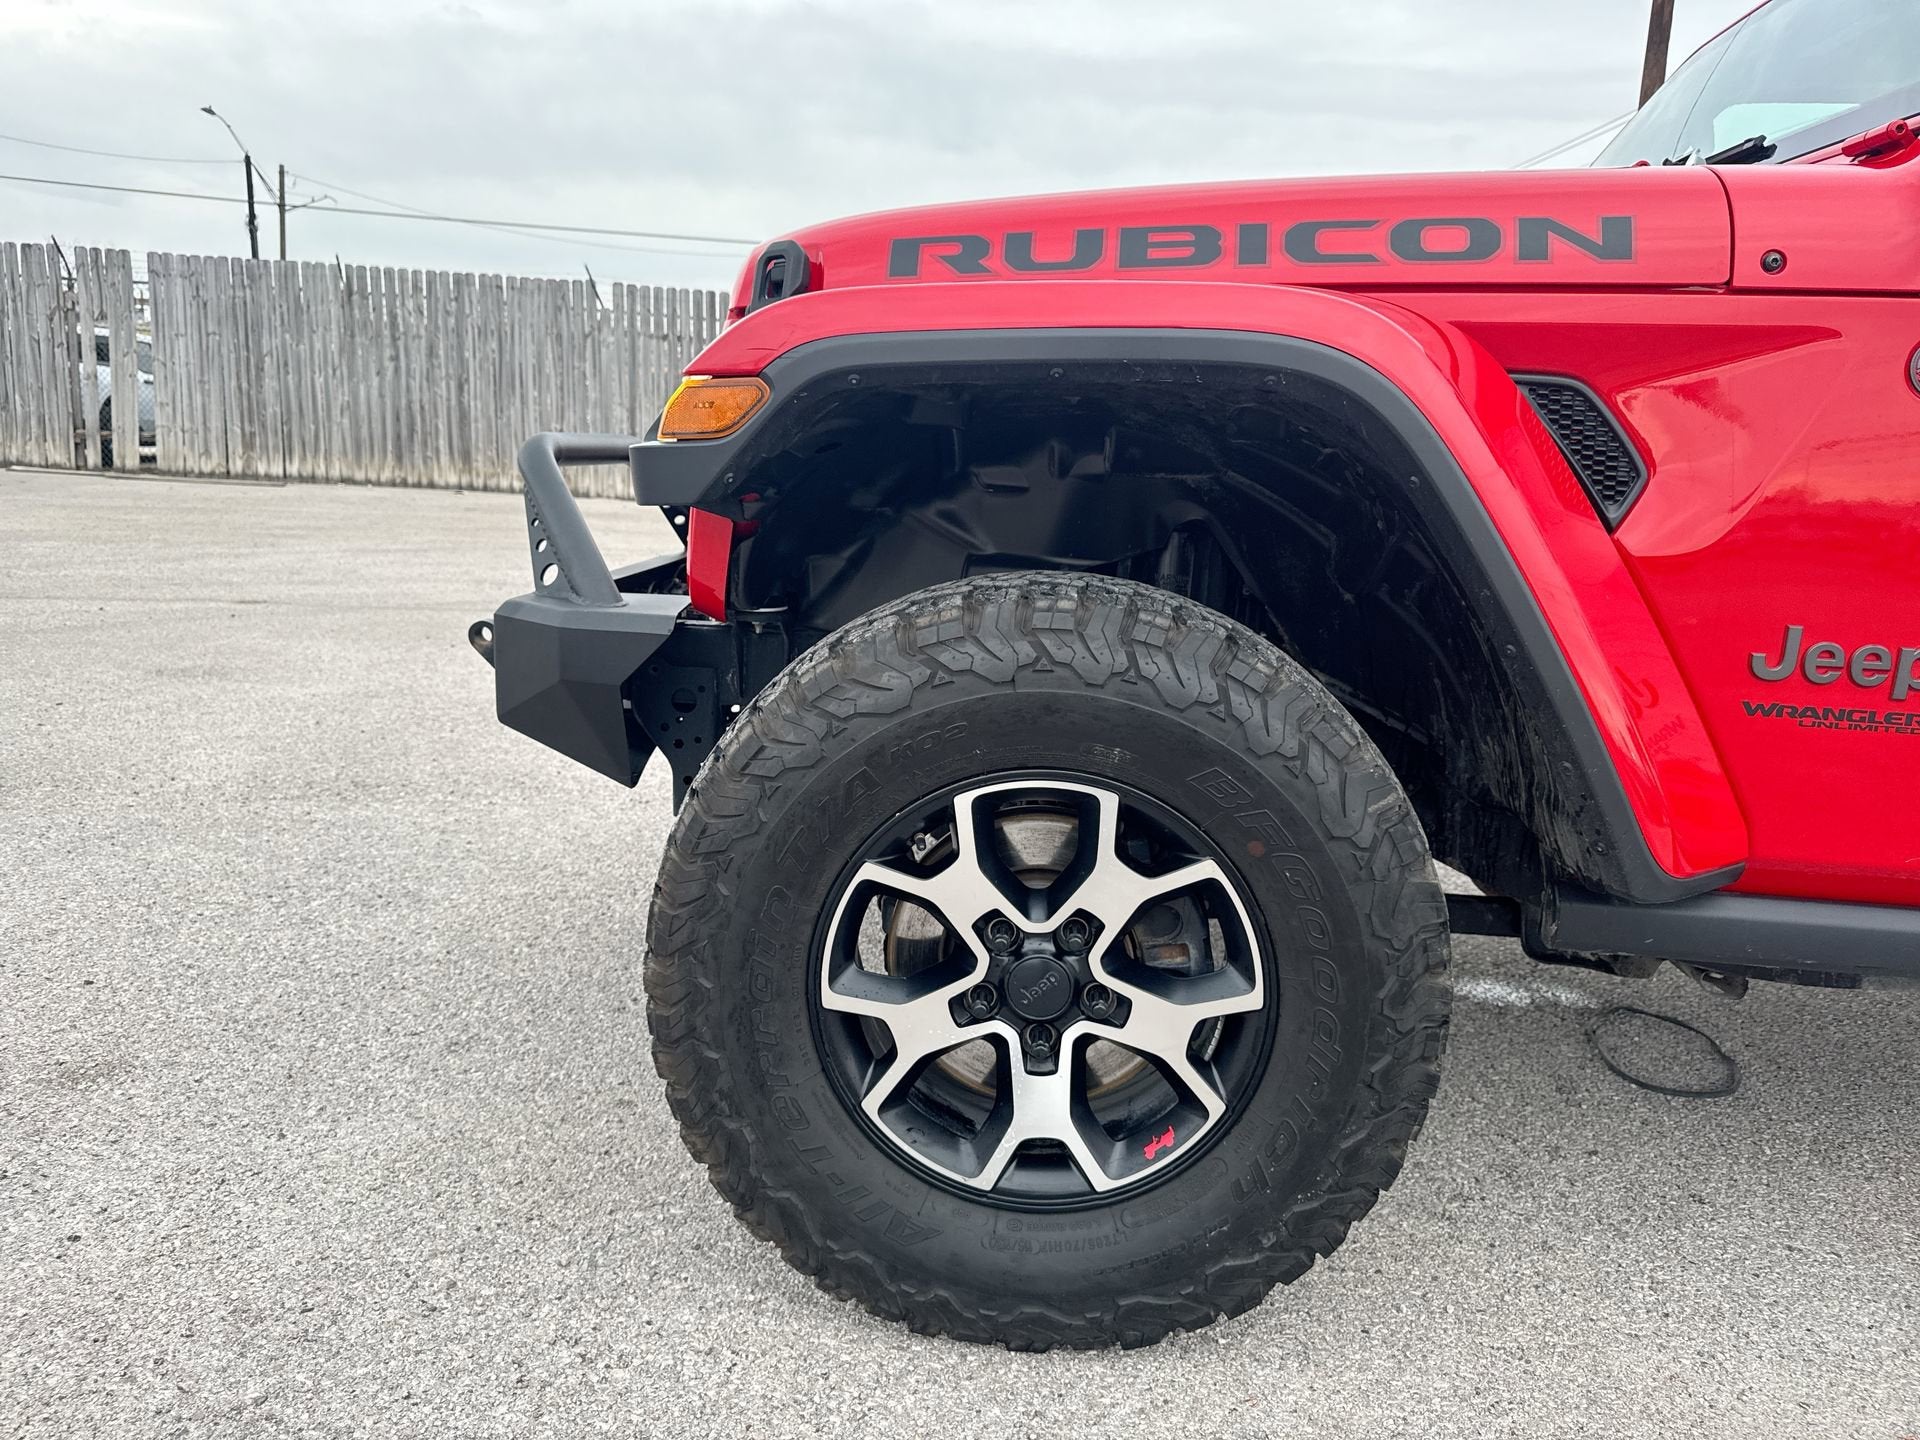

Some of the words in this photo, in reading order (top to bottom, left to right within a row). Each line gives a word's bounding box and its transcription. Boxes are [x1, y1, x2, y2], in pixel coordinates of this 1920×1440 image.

[887, 215, 1633, 278] RUBICON
[1750, 624, 1920, 700] Jeep
[1741, 699, 1920, 727] WRANGLER
[1019, 971, 1061, 1005] Jeep
